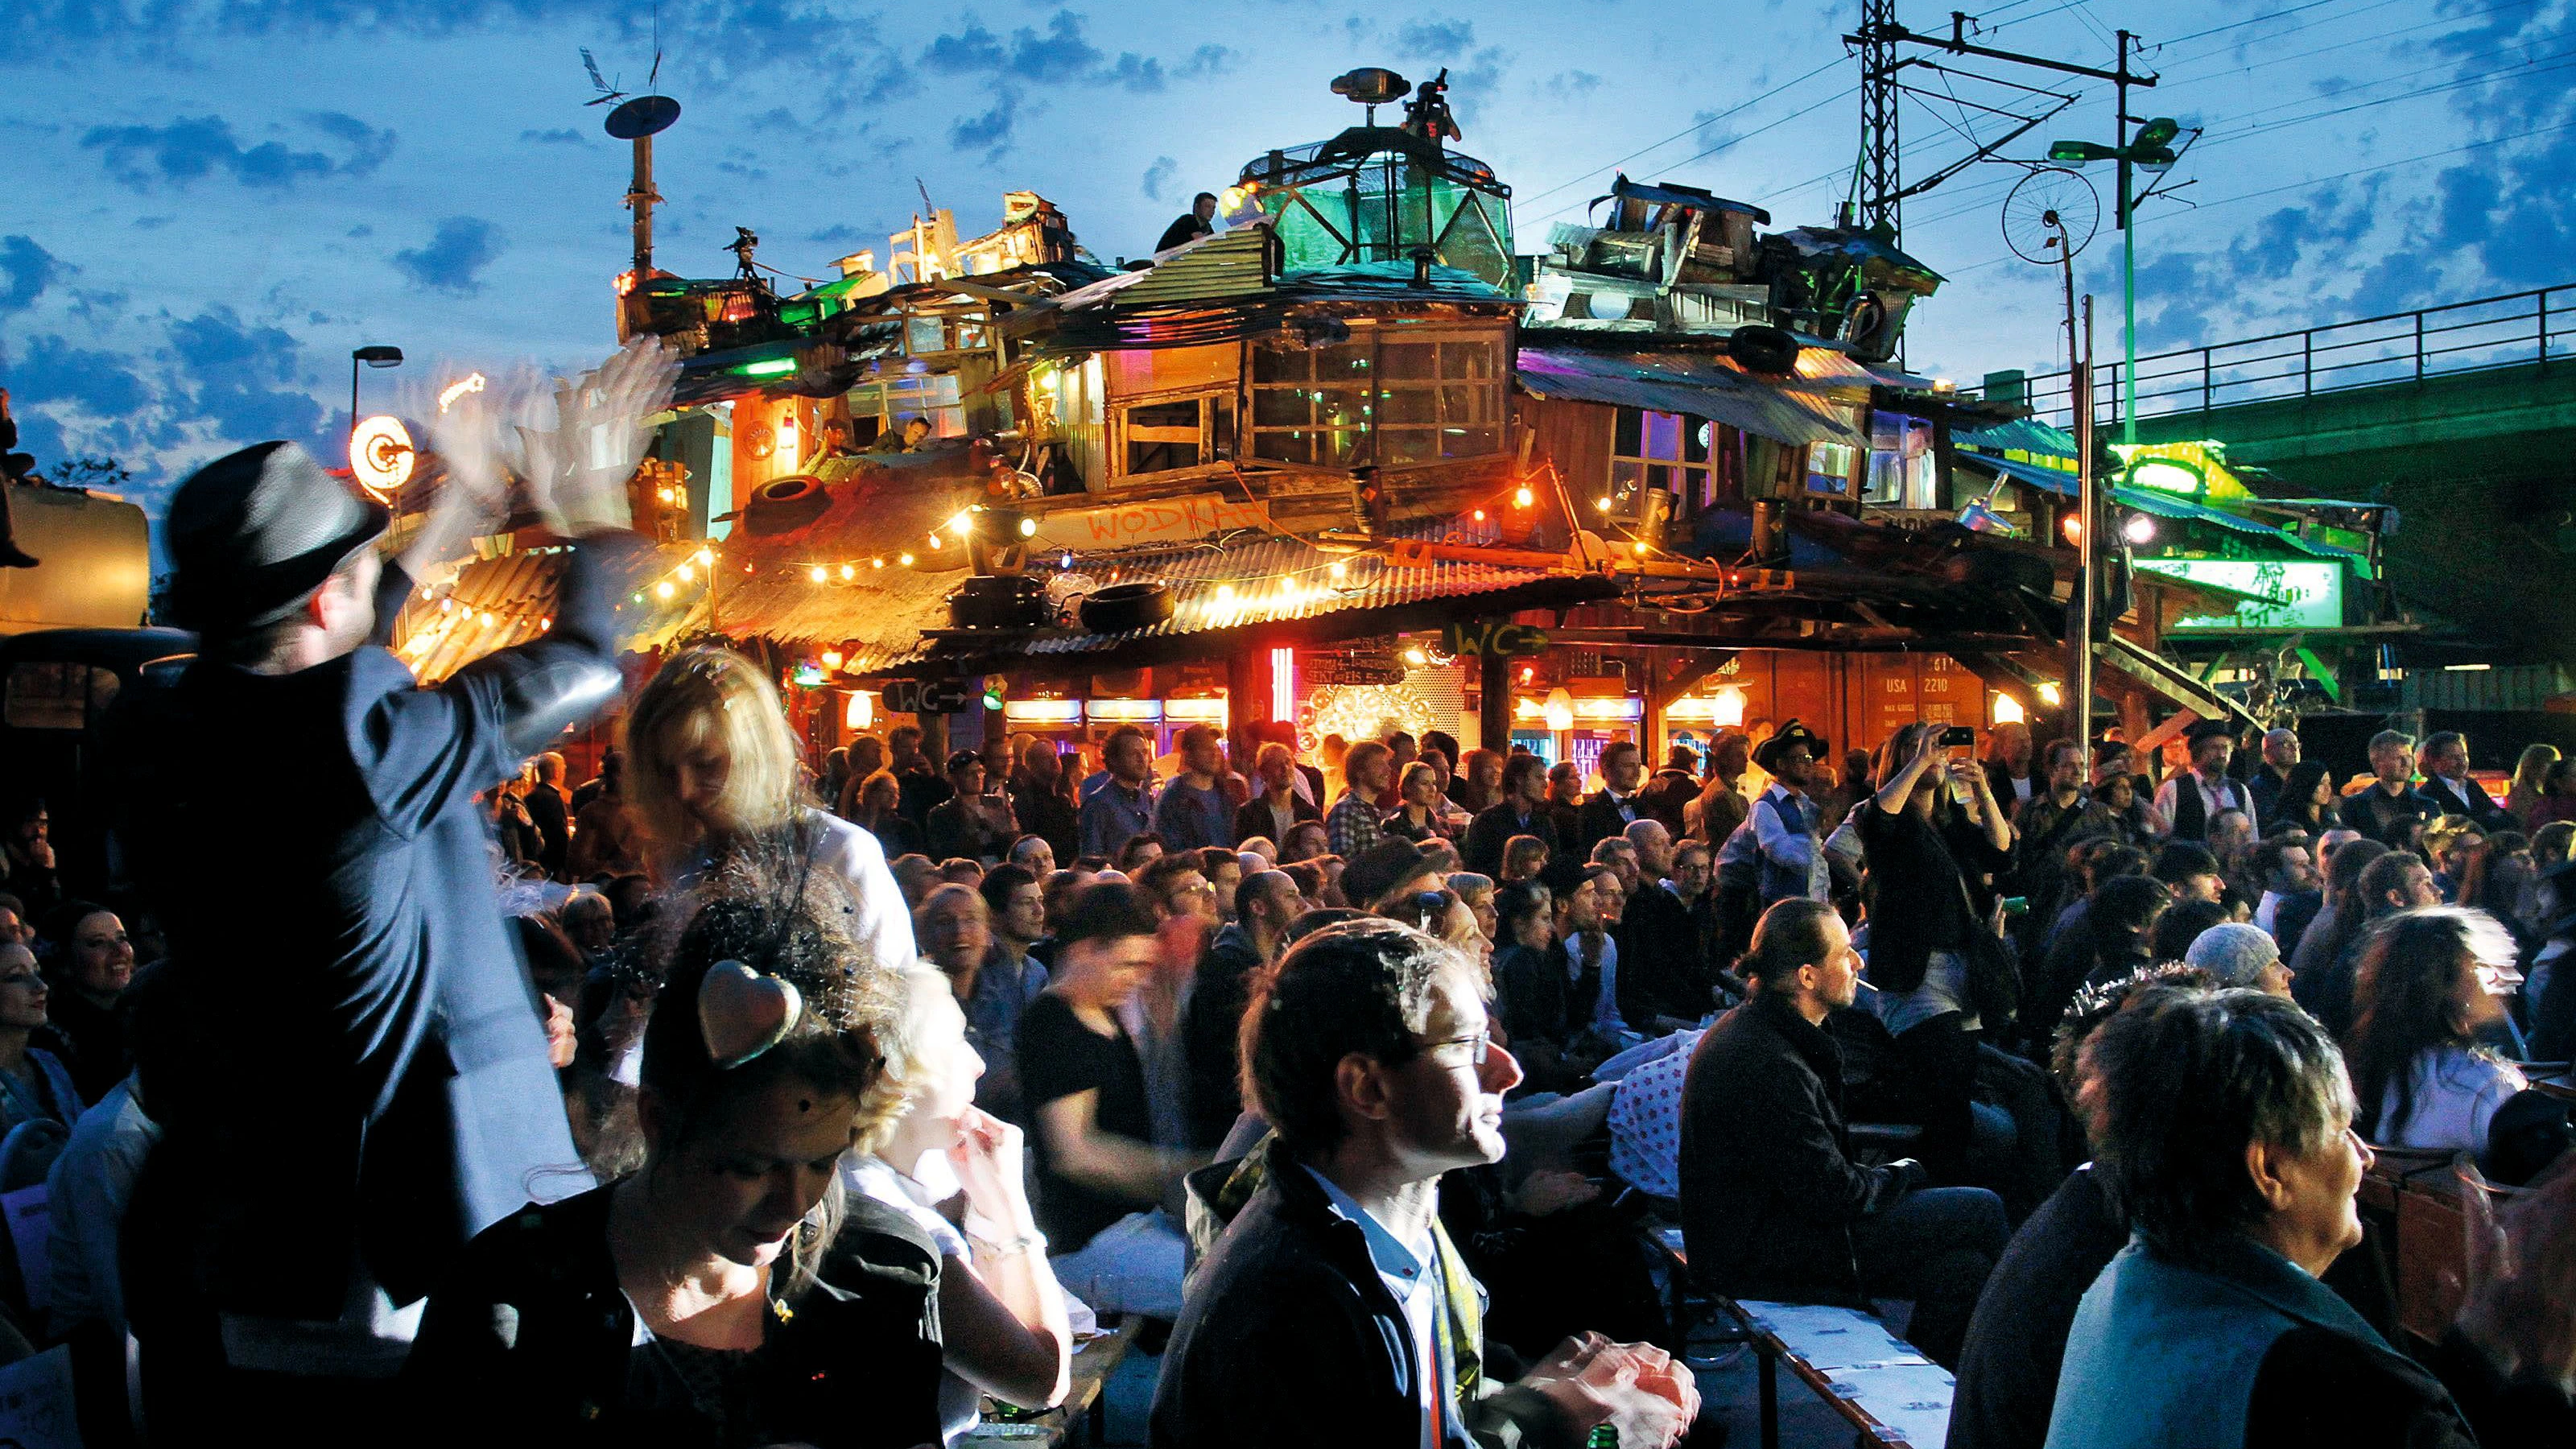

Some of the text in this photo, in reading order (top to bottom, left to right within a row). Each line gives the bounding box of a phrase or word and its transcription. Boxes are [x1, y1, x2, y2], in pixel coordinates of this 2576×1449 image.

[1454, 623, 1521, 655] WC
[897, 682, 939, 712] WC
[1886, 678, 1948, 692] USA 2210
